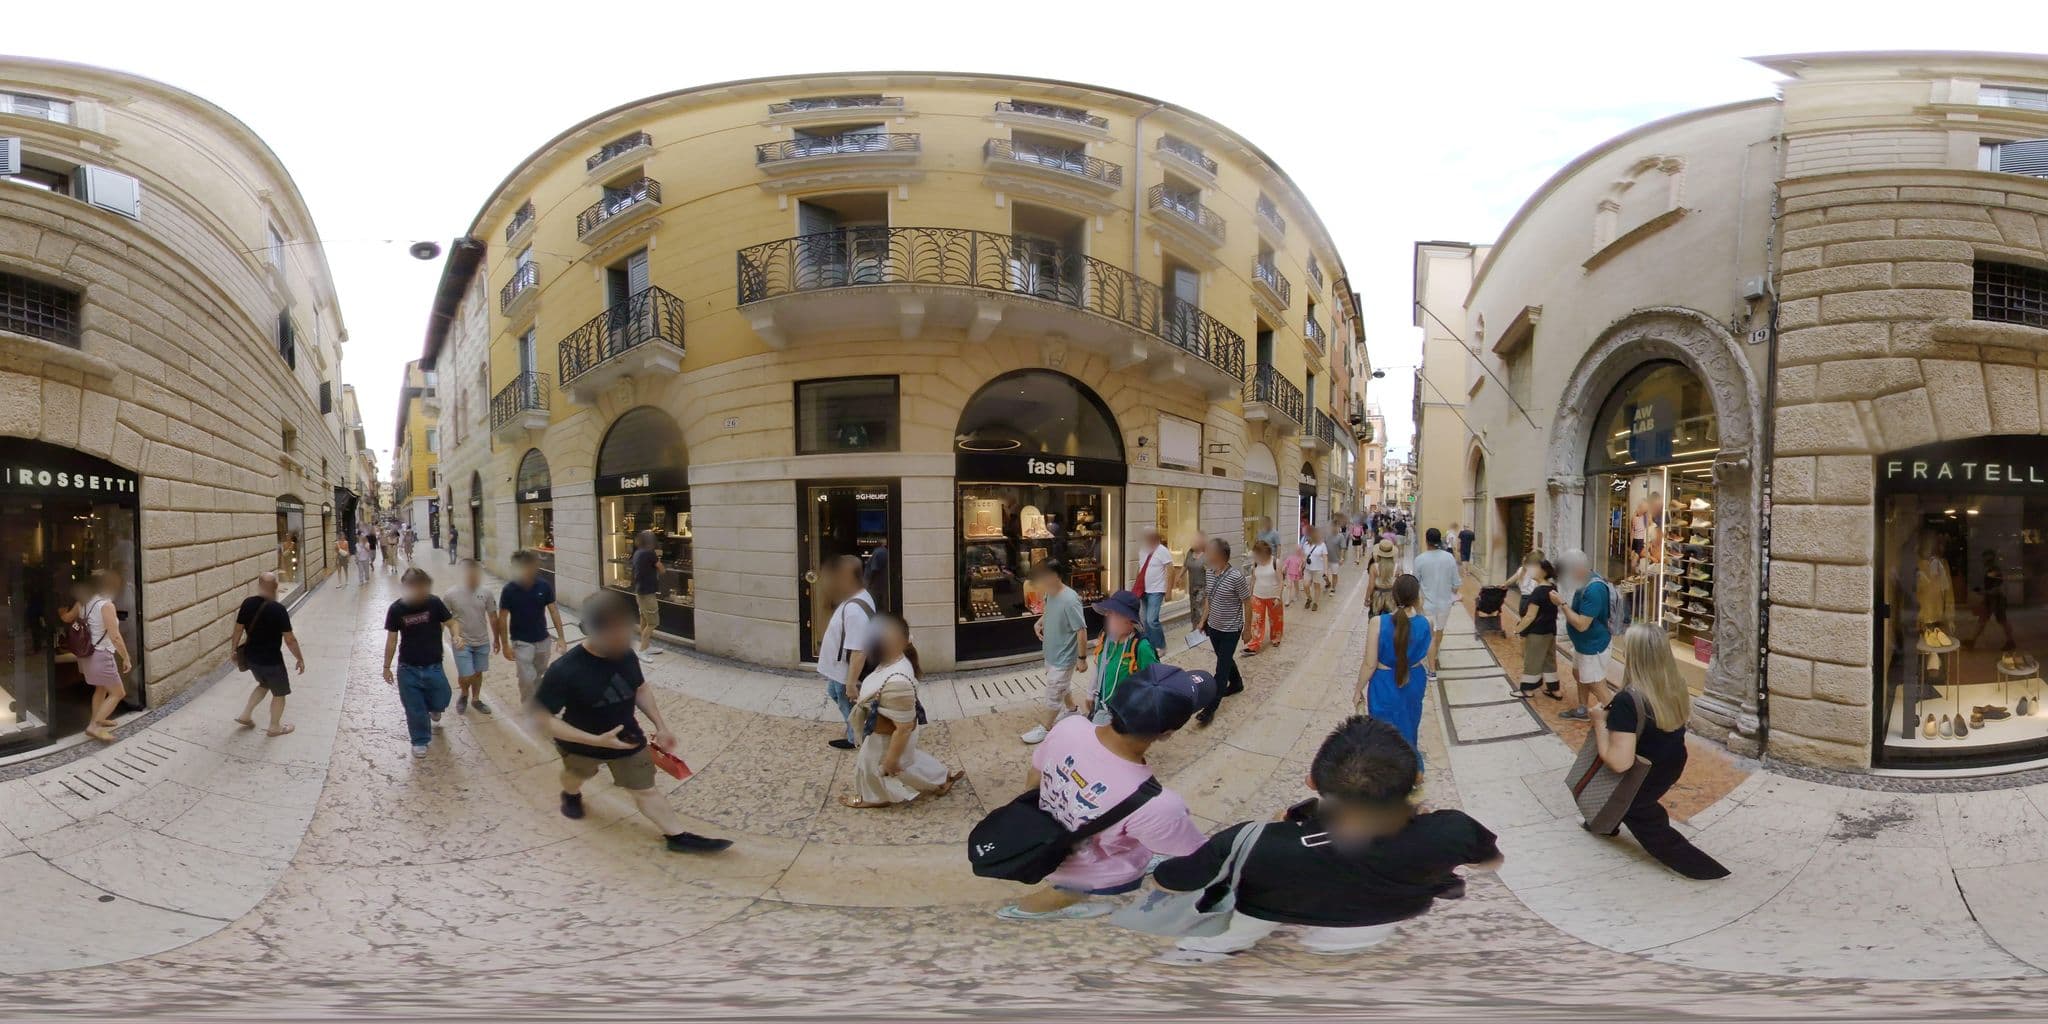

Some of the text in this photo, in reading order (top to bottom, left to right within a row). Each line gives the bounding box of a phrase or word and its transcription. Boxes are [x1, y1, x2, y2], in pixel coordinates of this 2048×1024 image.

[1633, 405, 1653, 421] AW
[1632, 419, 1655, 434] LAB
[1027, 458, 1075, 476] fasoli
[1888, 461, 2045, 483] FRATELL
[19, 468, 134, 493] ROSSETTI
[620, 474, 649, 489] fasoli
